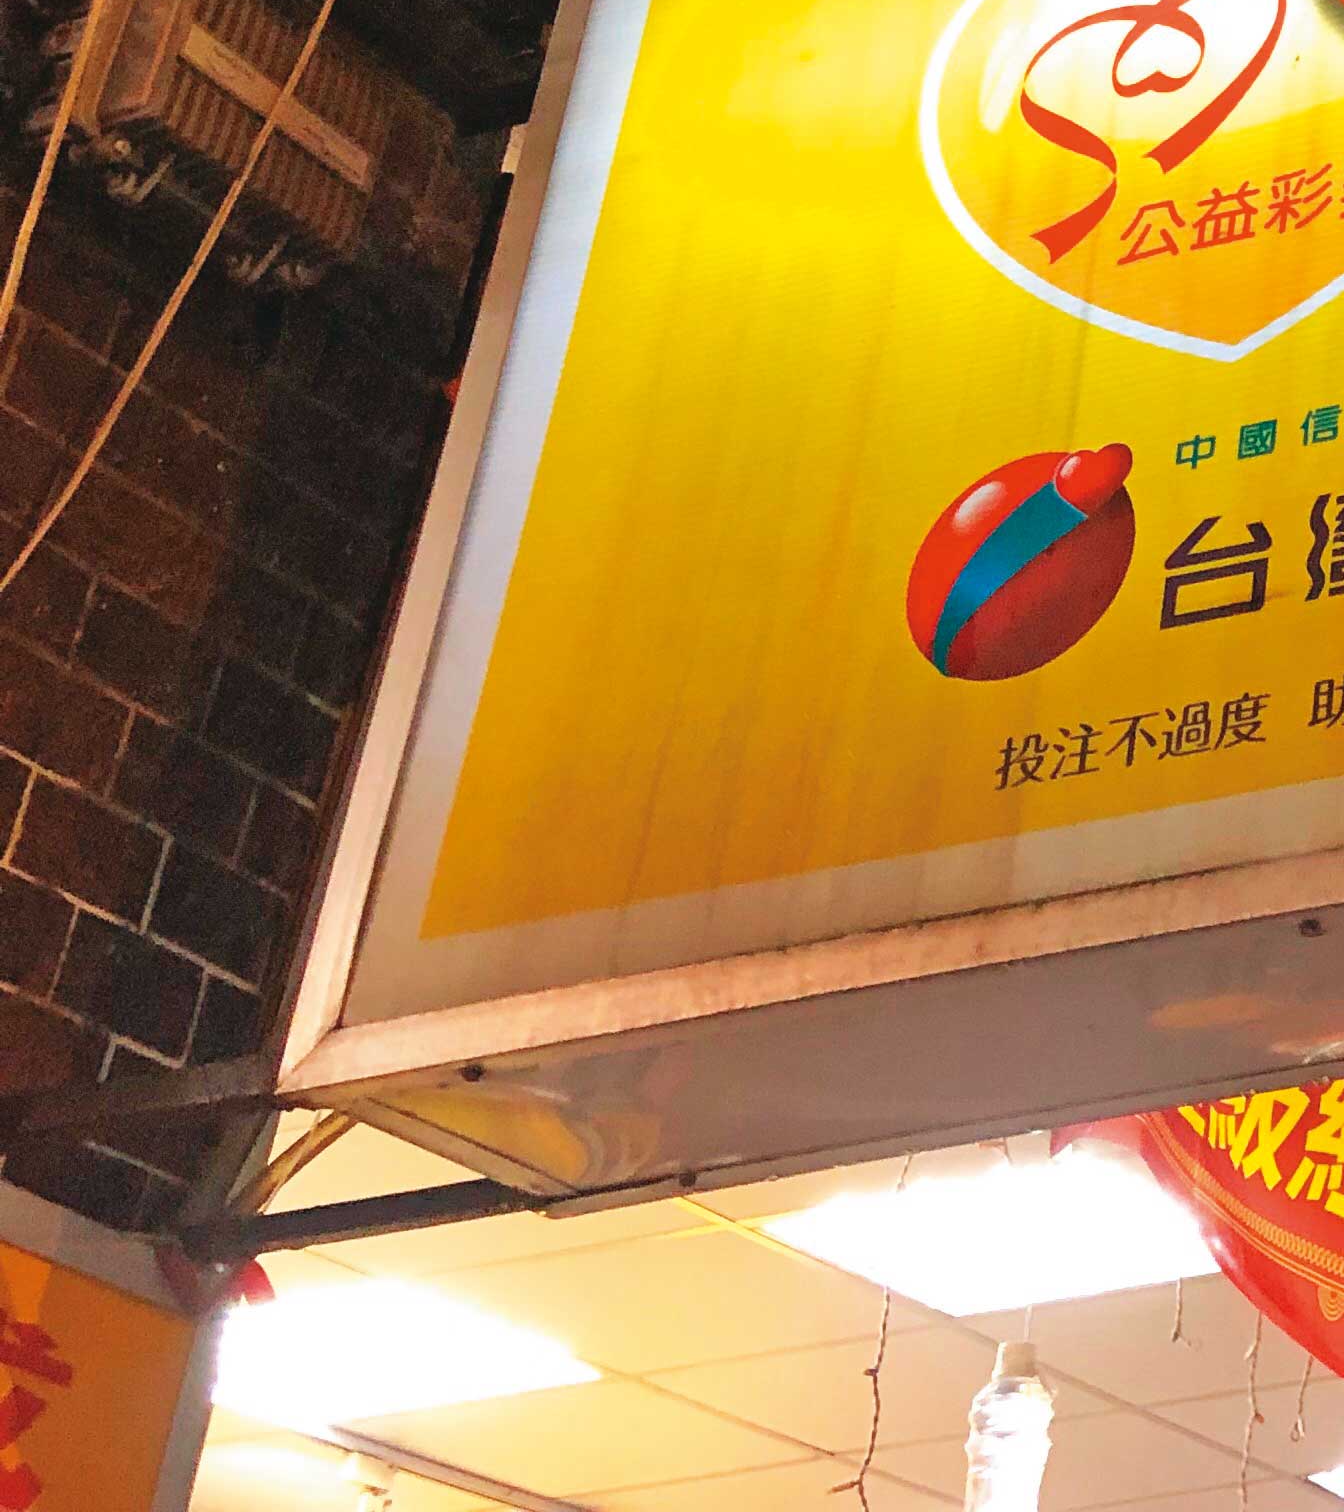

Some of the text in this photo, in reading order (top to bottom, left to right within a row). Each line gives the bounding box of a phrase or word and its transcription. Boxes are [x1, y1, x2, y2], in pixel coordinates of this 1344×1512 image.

[994, 692, 1271, 789] 投注不過度
